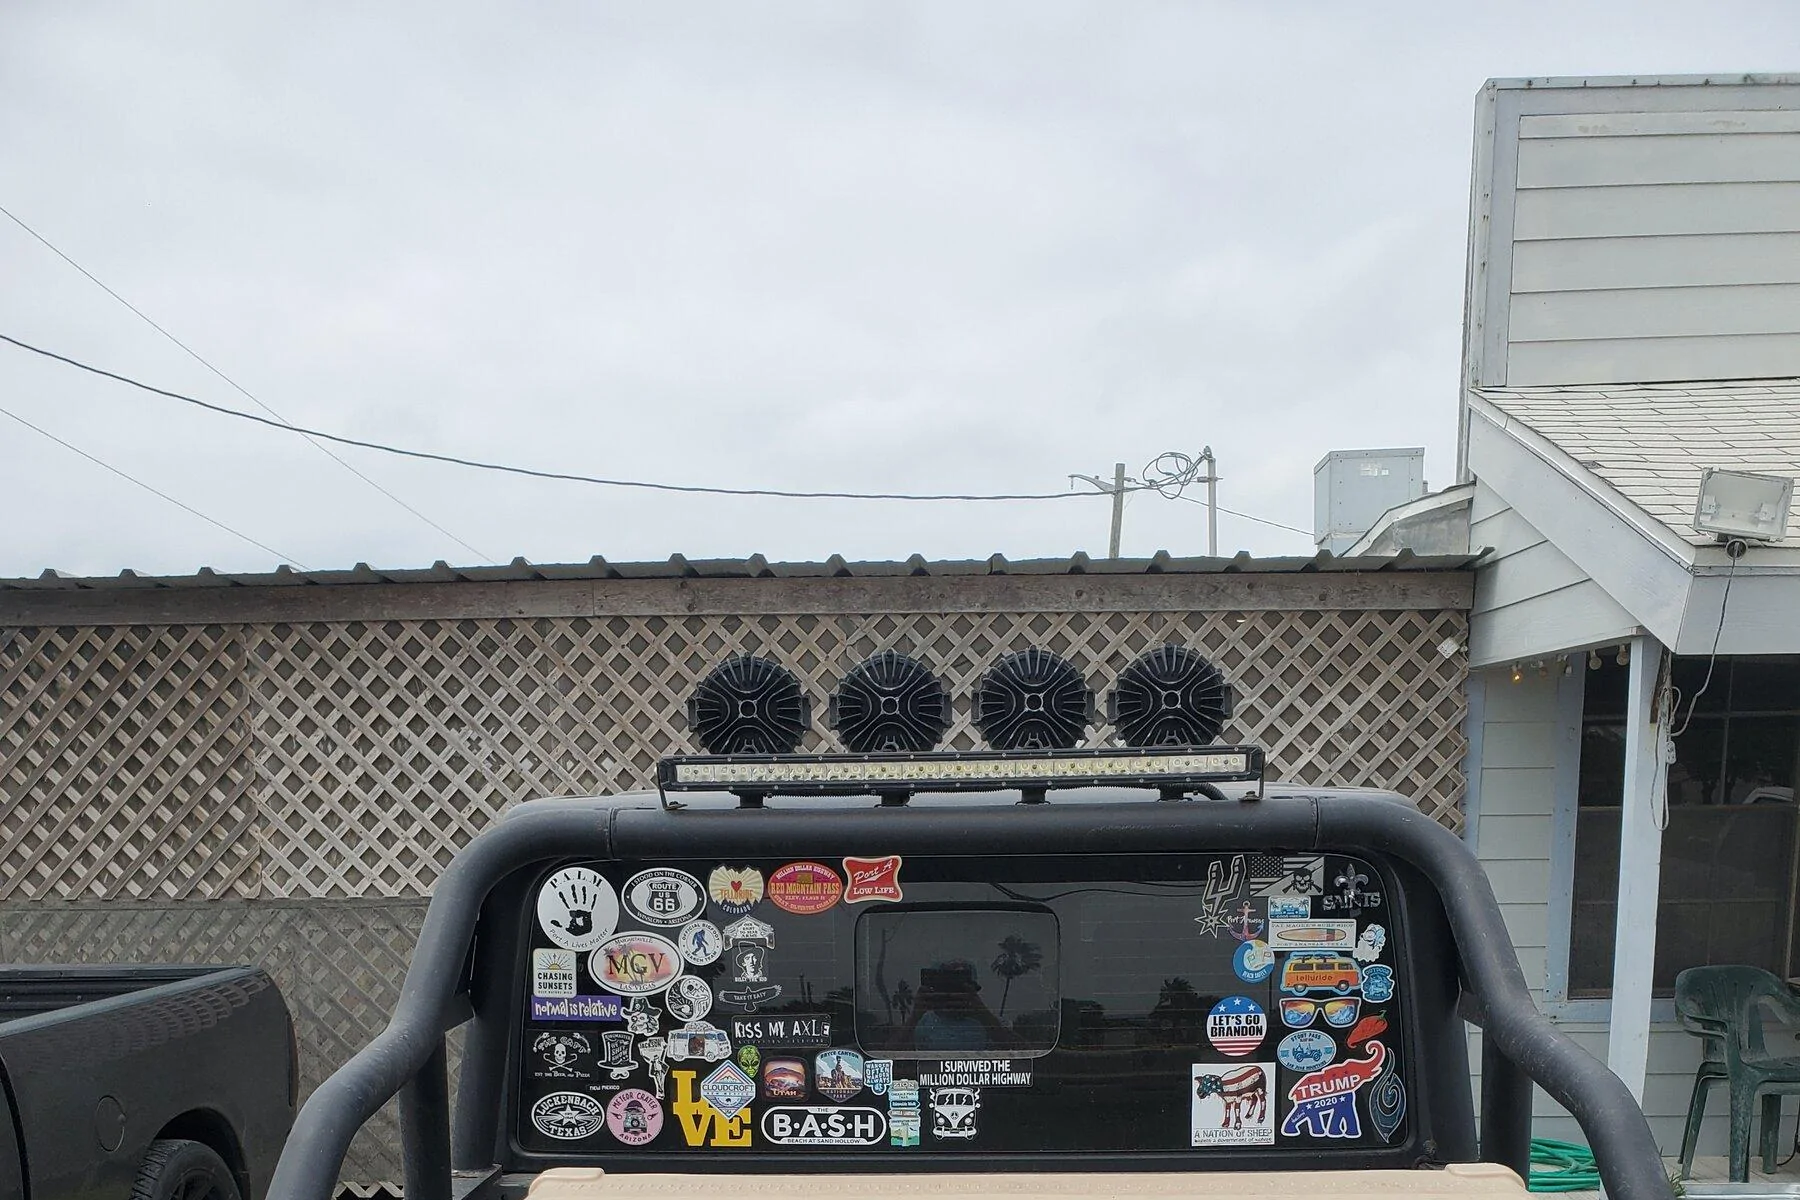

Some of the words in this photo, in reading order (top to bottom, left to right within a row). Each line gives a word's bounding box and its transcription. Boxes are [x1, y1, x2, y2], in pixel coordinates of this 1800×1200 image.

[854, 866, 879, 884] Port
[883, 859, 892, 871] A
[635, 872, 653, 884] STOOD
[676, 873, 698, 888] CORNER
[771, 883, 784, 894] RED
[786, 883, 821, 894] MOUNTAIN
[823, 883, 839, 894] PASS
[654, 898, 675, 911] 66
[1322, 892, 1380, 910] SAINTS
[550, 929, 562, 942] Port
[606, 952, 666, 974] MGV
[538, 982, 573, 990] SUNSETS
[535, 999, 568, 1017] normal
[570, 1003, 578, 1016] is
[579, 998, 617, 1018] relative
[1213, 1015, 1242, 1026] LET'S
[1245, 1015, 1260, 1025] GO
[735, 1021, 763, 1038] KISS
[792, 1020, 830, 1037] AXLE
[1211, 1026, 1263, 1037] BRANDON
[941, 1061, 943, 1072] I
[945, 1061, 991, 1072] SURVIVED
[992, 1060, 1010, 1071] THE
[920, 1074, 954, 1086] MILLION
[957, 1073, 989, 1085] DOLLAR
[992, 1073, 1031, 1085] HIGHWAY
[1297, 1075, 1360, 1098] TRUMP
[537, 1096, 599, 1115] LUCKENBACH
[613, 1092, 633, 1109] METEOR
[637, 1093, 657, 1109] CRATER
[1314, 1097, 1337, 1108] 2020
[549, 1125, 587, 1136] TEXAS
[1247, 1129, 1272, 1137] SHEEP
[620, 1134, 652, 1142] ARIZONA
